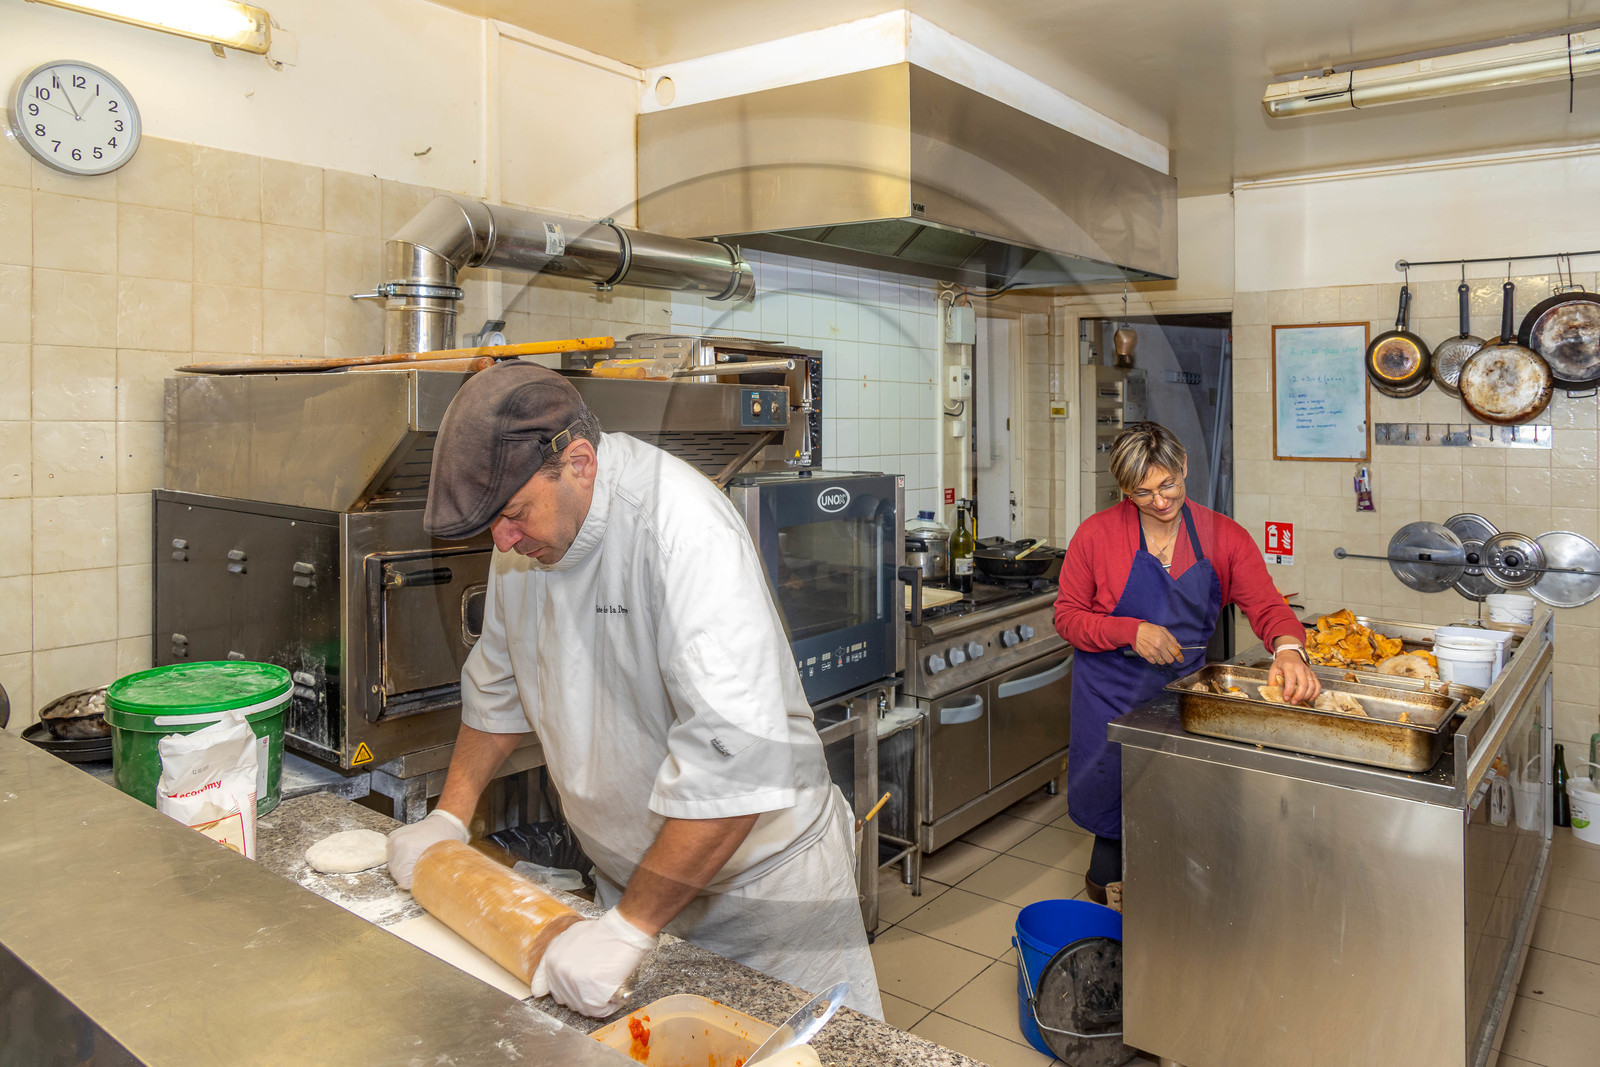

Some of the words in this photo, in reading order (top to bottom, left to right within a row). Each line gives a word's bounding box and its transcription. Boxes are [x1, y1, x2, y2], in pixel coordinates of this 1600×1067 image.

[52, 75, 60, 89] 11
[72, 74, 86, 89] 12
[35, 86, 50, 100] 10
[95, 84, 100, 96] 1
[28, 103, 39, 116] 9
[108, 100, 118, 113] 2
[34, 123, 46, 137] 8
[114, 119, 124, 132] 3
[51, 139, 62, 153] 7
[107, 136, 118, 149] 4
[71, 148, 82, 161] 6
[93, 146, 103, 160] 5
